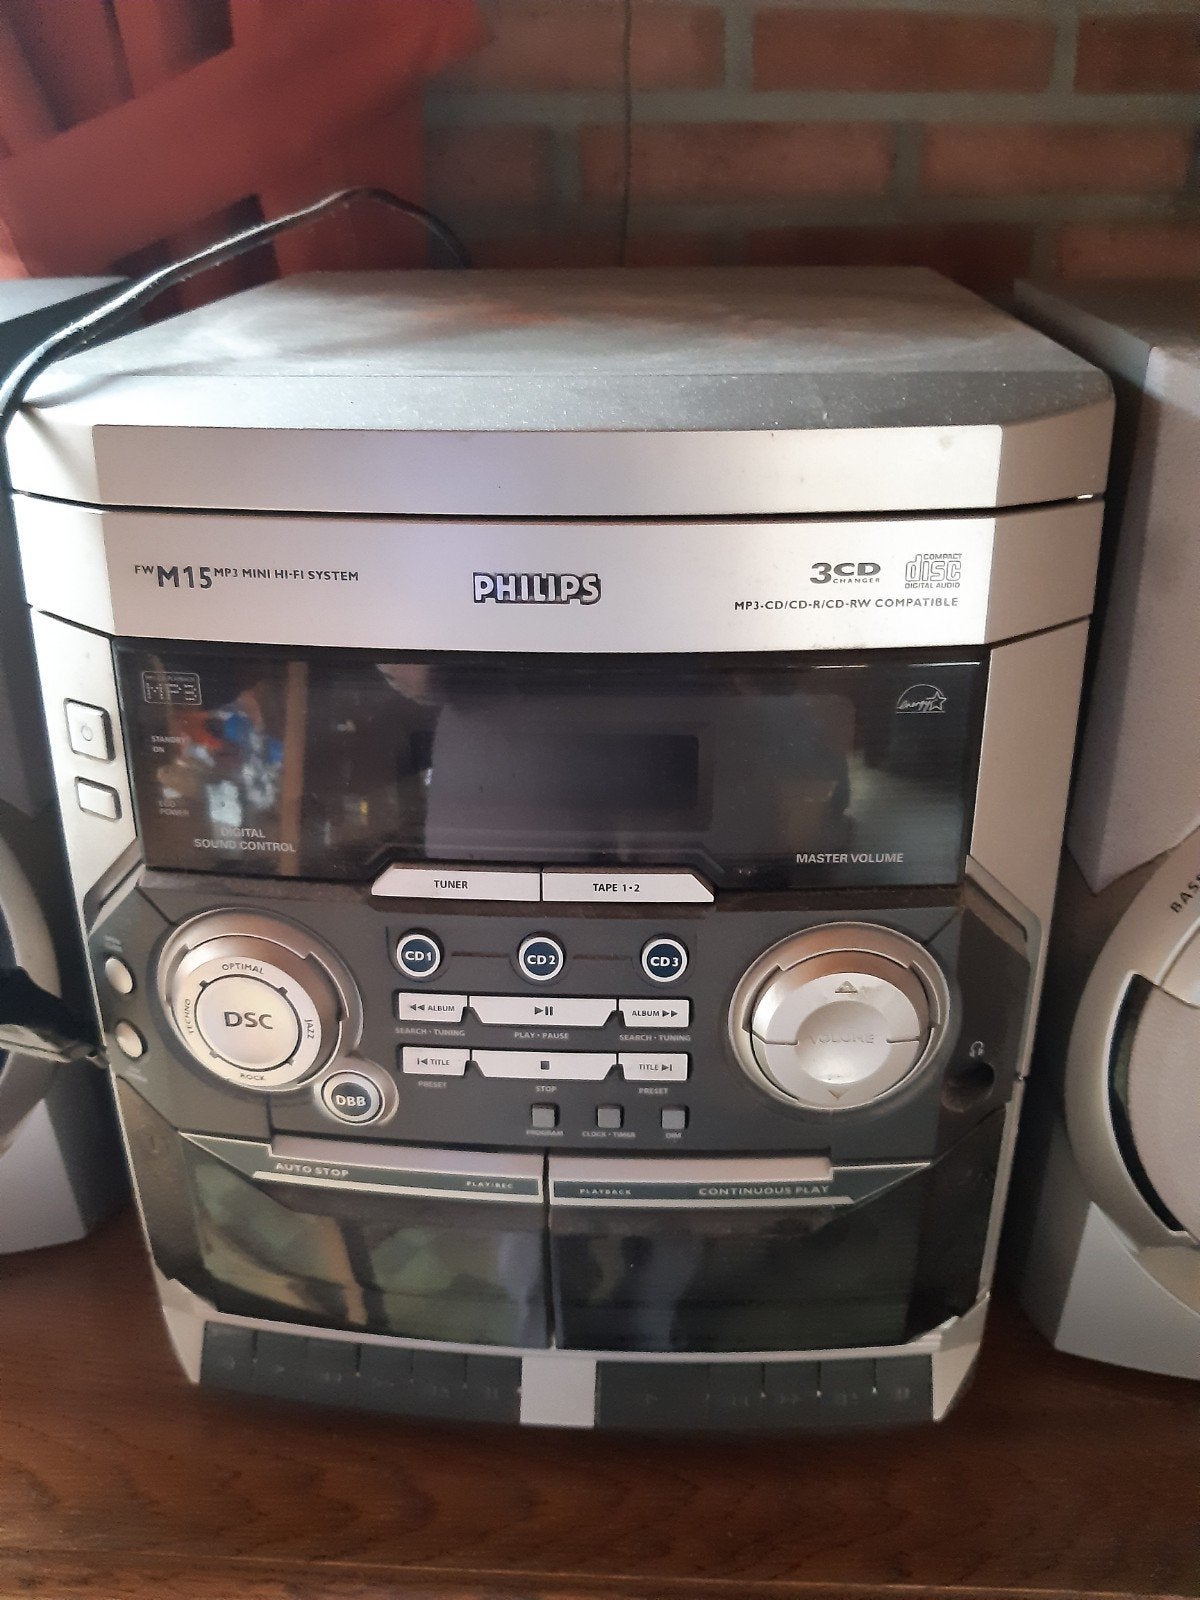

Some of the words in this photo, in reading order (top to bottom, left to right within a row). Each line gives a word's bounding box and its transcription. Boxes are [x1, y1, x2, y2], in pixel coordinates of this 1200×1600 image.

[157, 565, 213, 589] M15
[214, 568, 239, 578] MP3
[242, 568, 271, 579] MINI
[274, 569, 304, 580] HI-FI
[307, 570, 359, 581] SYSTEM
[473, 572, 601, 605] PHILIPS
[734, 599, 871, 611] MP3-CD/CD-R/CD-RW
[875, 597, 959, 609] COMPATIBLE
[220, 827, 266, 838] DIGITAL
[194, 838, 238, 849] SOUND
[240, 840, 297, 853] CONTROL
[796, 853, 848, 863] MASTER
[850, 853, 904, 863] VOLUME
[433, 879, 468, 890] TUNER
[592, 883, 618, 892] TAPE
[221, 962, 264, 975] OPTIMAL
[427, 1003, 455, 1012] ALBUM
[184, 998, 194, 1034] TECHNO
[631, 1009, 660, 1018] ALBUM
[224, 1011, 273, 1030] DSC
[305, 1019, 315, 1040] JAZZ
[395, 1027, 427, 1035] SEARCH
[433, 1028, 465, 1037] TUNING
[514, 1031, 535, 1040] PLAY
[542, 1032, 569, 1040] PAUSE
[619, 1033, 652, 1042] SEARCH
[659, 1034, 691, 1042] TUNING
[430, 1058, 450, 1066] TITLE
[638, 1063, 659, 1072] TITLE
[239, 1072, 266, 1082] ROCK
[535, 1085, 557, 1093] STOP
[335, 1095, 367, 1107] DBB
[276, 1162, 312, 1174] AUTO
[314, 1166, 349, 1178] STOP
[579, 1187, 632, 1196] PLAYBACK
[698, 1186, 791, 1196] CONTINUOUS
[795, 1185, 829, 1195] PLAY
